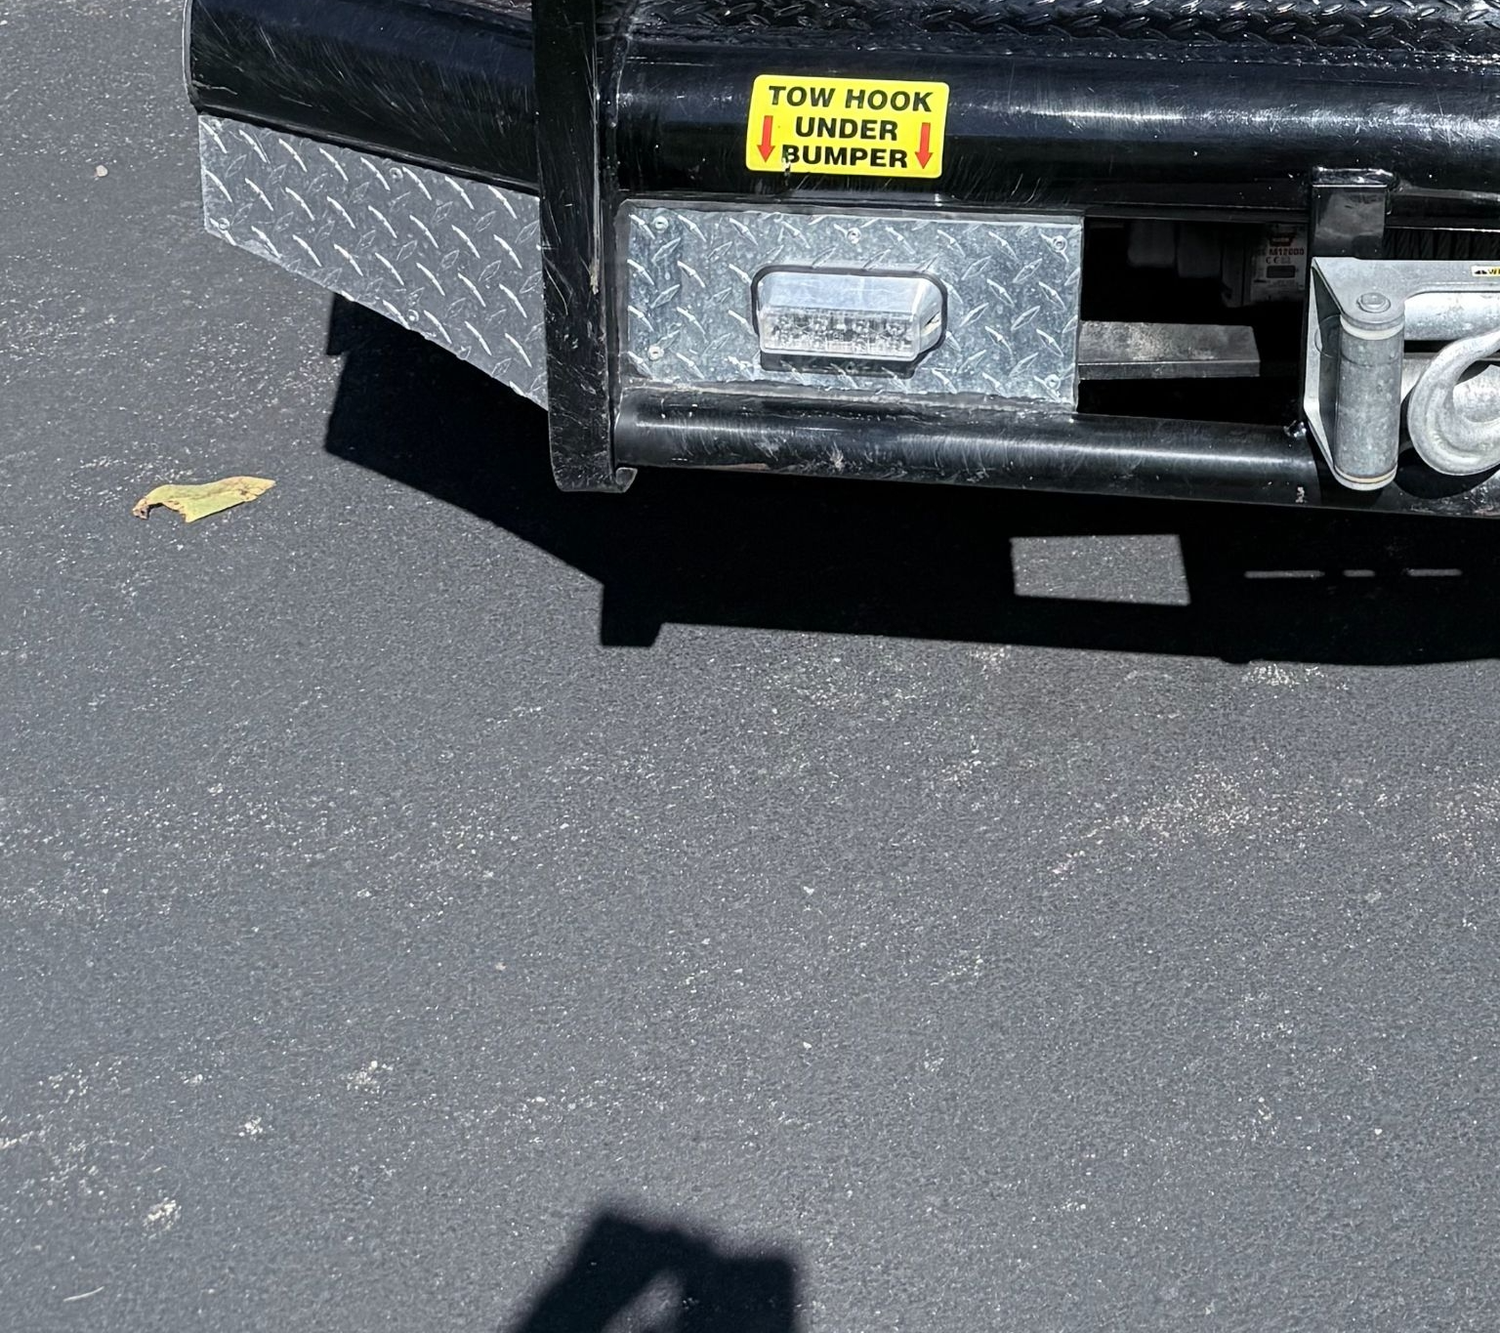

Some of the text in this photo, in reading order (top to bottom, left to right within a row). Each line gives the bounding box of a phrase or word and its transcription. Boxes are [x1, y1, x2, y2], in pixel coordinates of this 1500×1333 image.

[768, 84, 934, 113] TOW HOOK
[795, 116, 899, 141] UNDER
[781, 144, 908, 168] BUMPER
